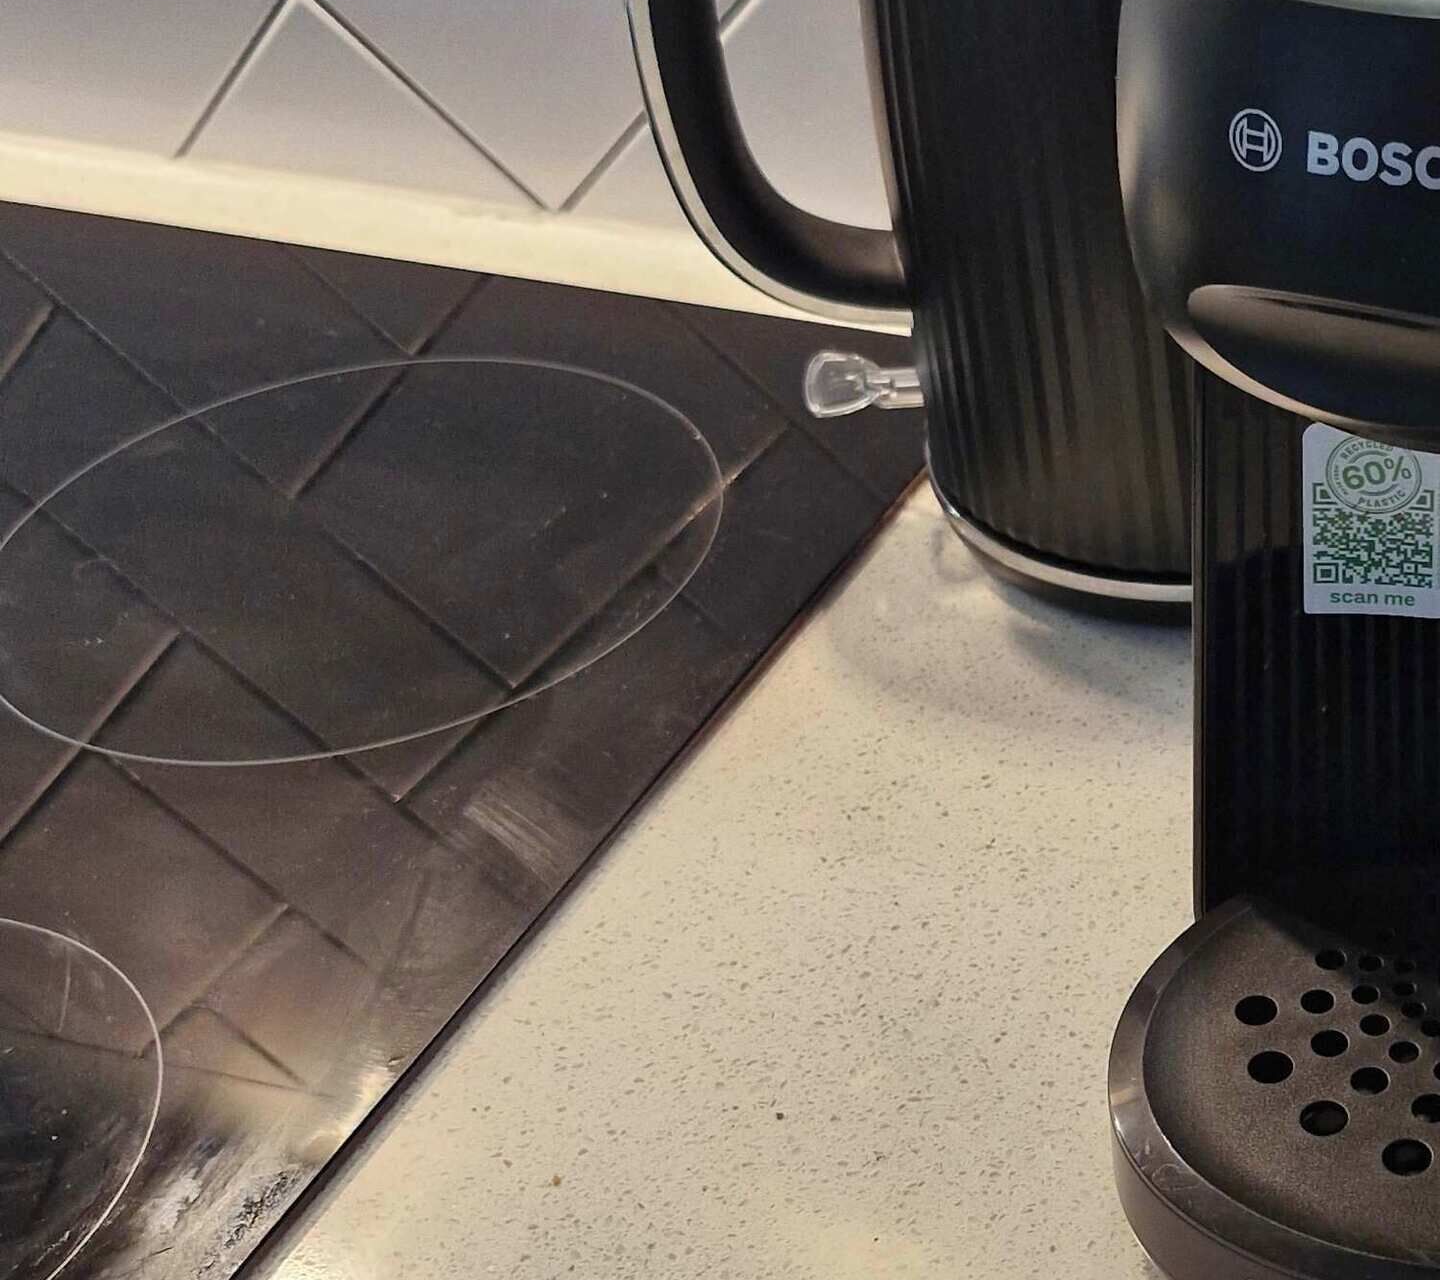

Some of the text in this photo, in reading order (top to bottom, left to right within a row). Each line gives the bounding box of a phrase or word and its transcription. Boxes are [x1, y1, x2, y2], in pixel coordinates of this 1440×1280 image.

[1342, 455, 1412, 490] 60%
[1358, 490, 1406, 508] PLASTIC
[1329, 591, 1416, 607] scan me
